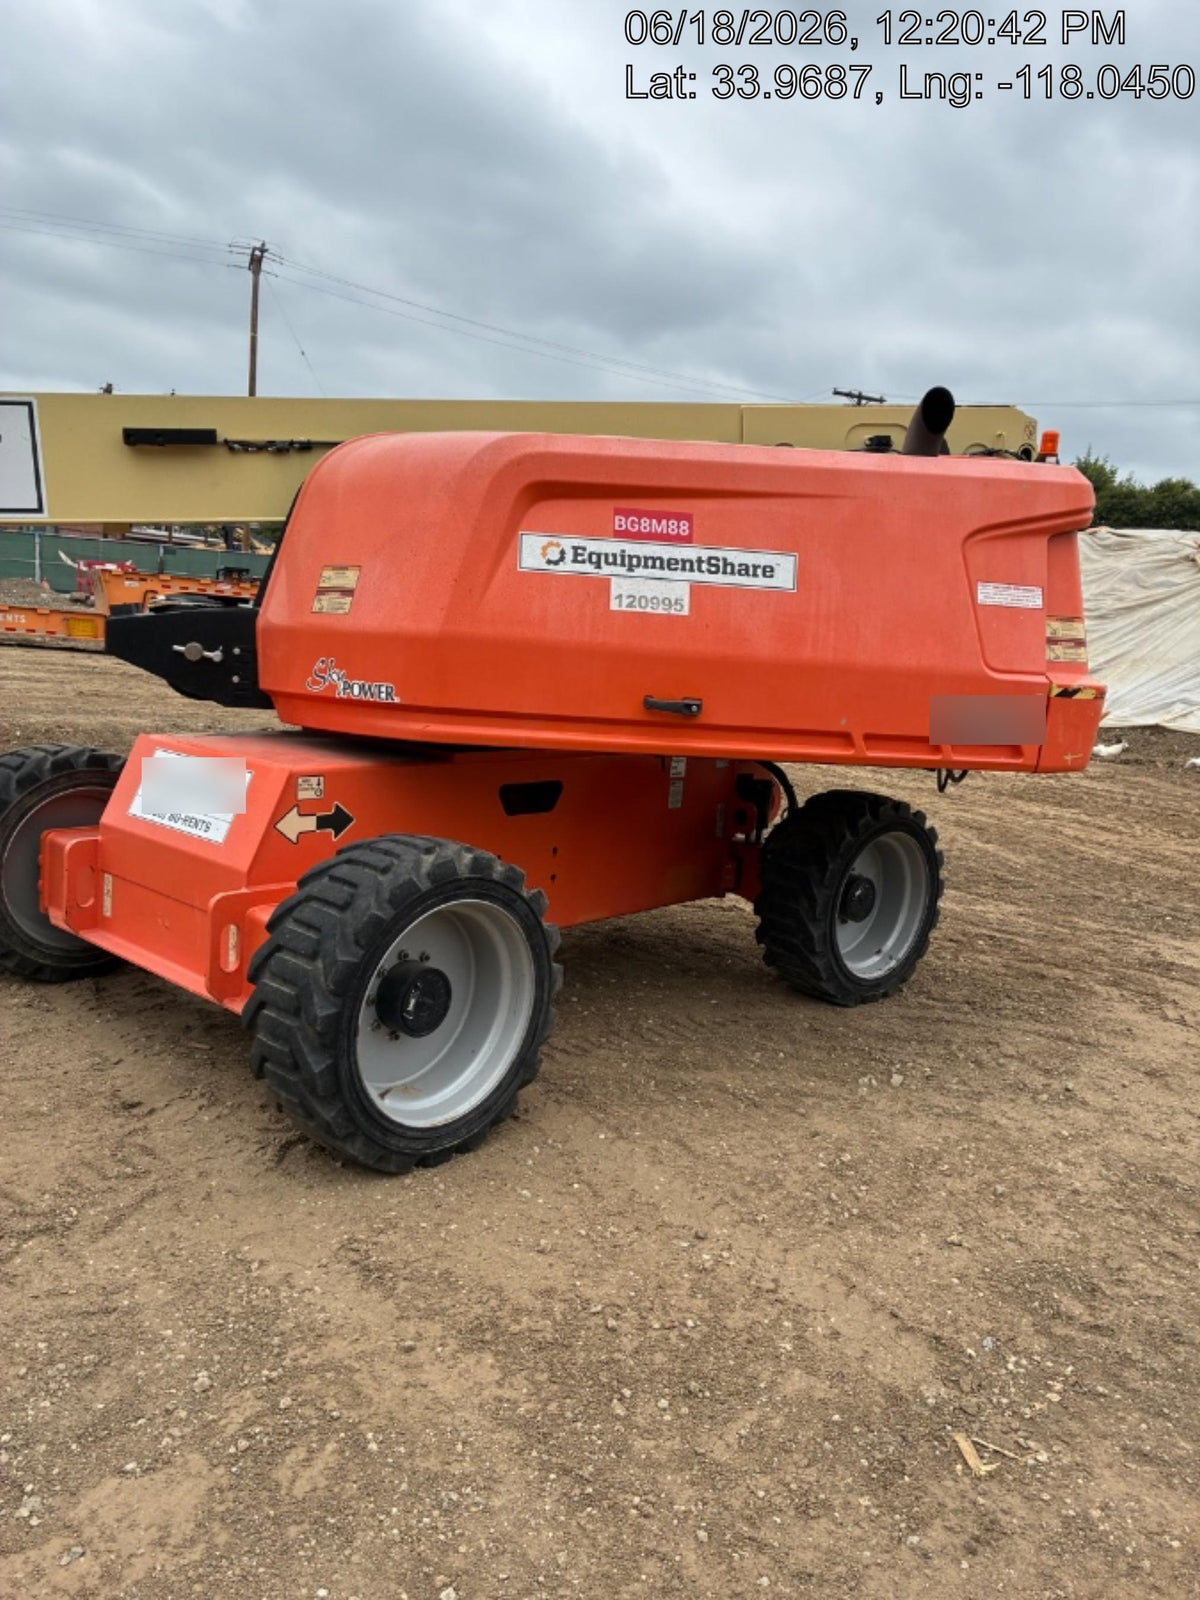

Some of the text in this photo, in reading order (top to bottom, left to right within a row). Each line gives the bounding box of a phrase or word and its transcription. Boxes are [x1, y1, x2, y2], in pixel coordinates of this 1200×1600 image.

[614, 515, 690, 536] BG8M88
[571, 545, 775, 579] EquipmentShare
[614, 593, 685, 613] 120995
